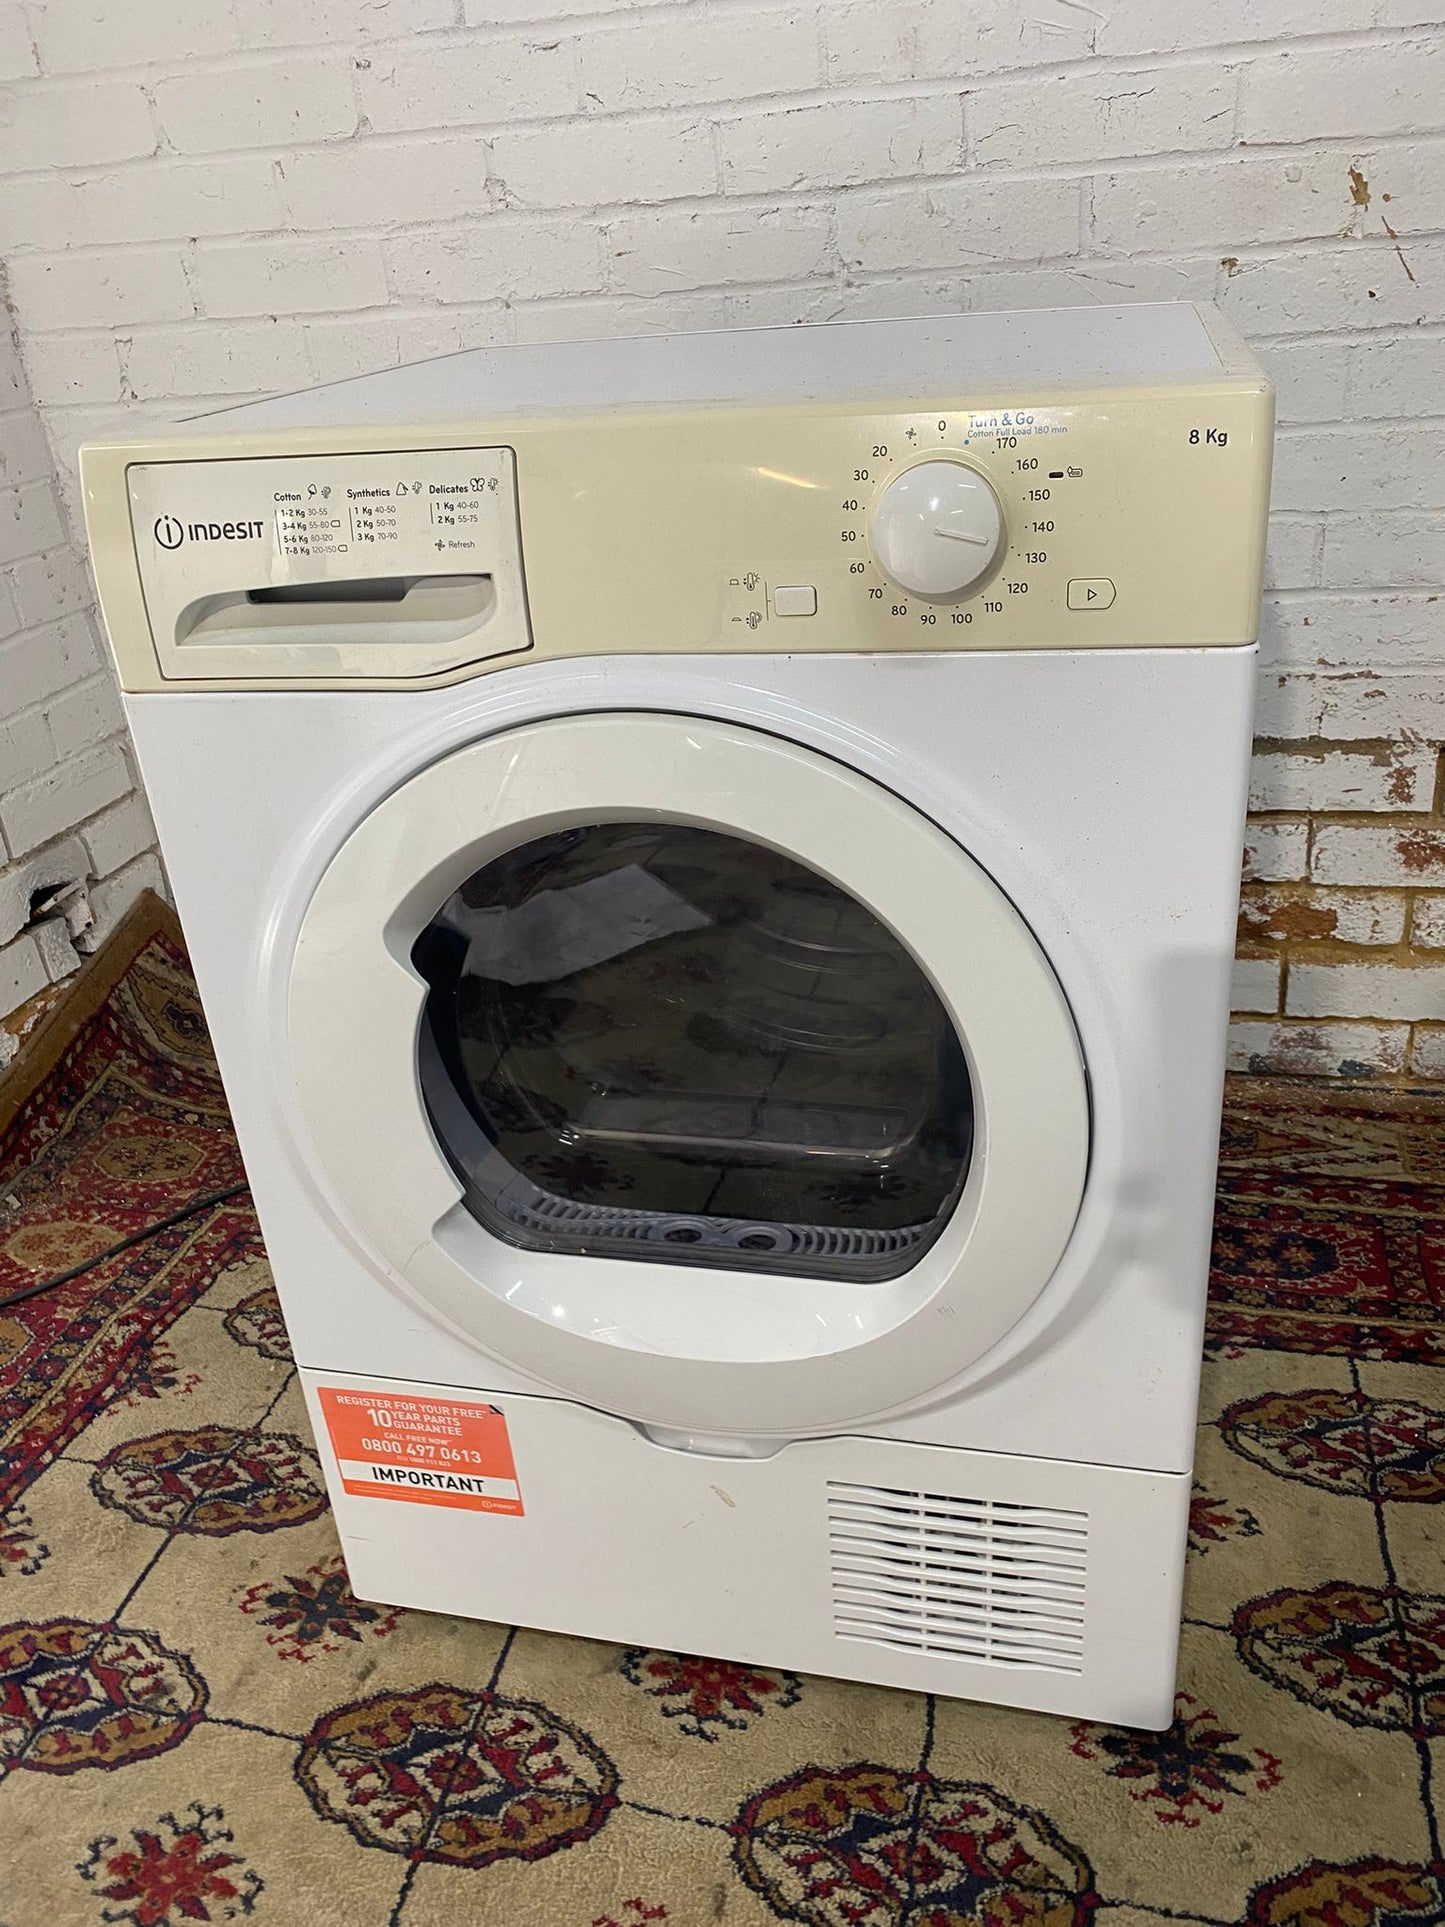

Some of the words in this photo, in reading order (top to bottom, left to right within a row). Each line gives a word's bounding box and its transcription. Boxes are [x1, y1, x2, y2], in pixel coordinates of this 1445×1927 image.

[968, 414, 998, 428] Turn
[1001, 412, 1013, 426] &
[1015, 411, 1035, 425] Go
[937, 420, 947, 432] 0
[967, 430, 994, 439] Cotton
[996, 427, 1010, 437] Full
[1012, 426, 1032, 436] Load
[1034, 425, 1049, 434] 180
[1051, 425, 1068, 434] min
[996, 436, 1017, 449] 170
[1188, 429, 1200, 444] 8
[1206, 428, 1228, 447] Kg
[872, 445, 888, 457] 20
[1016, 458, 1039, 471] 160
[853, 469, 869, 481] 30
[346, 488, 391, 500] Synthetics
[429, 484, 469, 494] Delicates
[1028, 488, 1051, 501] 150
[273, 492, 302, 502] Cotton
[354, 506, 359, 515] 1
[362, 506, 373, 516] Kg
[375, 505, 396, 514] 40-50
[436, 502, 440, 510] 1
[444, 501, 454, 512] Kg
[457, 501, 479, 509] 40-60
[842, 499, 858, 511] 40
[281, 508, 294, 517] 1-2
[295, 508, 306, 518] Kg
[307, 507, 328, 516] 30-55
[356, 519, 362, 528] 2
[363, 519, 374, 529] Kg
[376, 518, 397, 527] 50-70
[437, 515, 443, 524] 2
[444, 515, 455, 525] Kg
[458, 514, 478, 523] 55-75
[282, 522, 295, 531] 3-4
[297, 522, 307, 531] Kg
[309, 521, 330, 529] 55-80
[1032, 521, 1055, 533] 140
[283, 535, 297, 543] 5-6
[298, 535, 309, 544] Kg
[310, 533, 334, 542] 80-120
[357, 533, 363, 541] 3
[364, 532, 375, 542] Kg
[377, 532, 398, 540] 70-90
[841, 530, 856, 542] 50
[285, 546, 299, 555] 7-8
[300, 546, 310, 556] Kg
[312, 545, 337, 554] 120-150
[448, 540, 475, 549] Refresh
[1025, 552, 1047, 564] 130
[849, 562, 865, 574] 60
[868, 588, 883, 600] 70
[1007, 582, 1028, 594] 120
[891, 605, 907, 617] 80
[984, 601, 1003, 613] 110
[920, 614, 936, 626] 90
[951, 613, 972, 625] 100
[336, 1395, 393, 1409] REGISTER
[394, 1400, 417, 1412] FOR
[418, 1403, 451, 1416] YOUR
[452, 1407, 485, 1420] FREE
[367, 1408, 393, 1428] 10
[391, 1410, 421, 1422] YEAR
[423, 1414, 461, 1427] PARTS
[393, 1420, 463, 1437] GUARANTEE
[384, 1432, 405, 1441] CALL
[405, 1434, 428, 1443] FREE
[361, 1437, 402, 1454] 0800
[406, 1443, 435, 1458] 497
[440, 1446, 482, 1464] 0613
[371, 1466, 484, 1493] IMPORTANT
